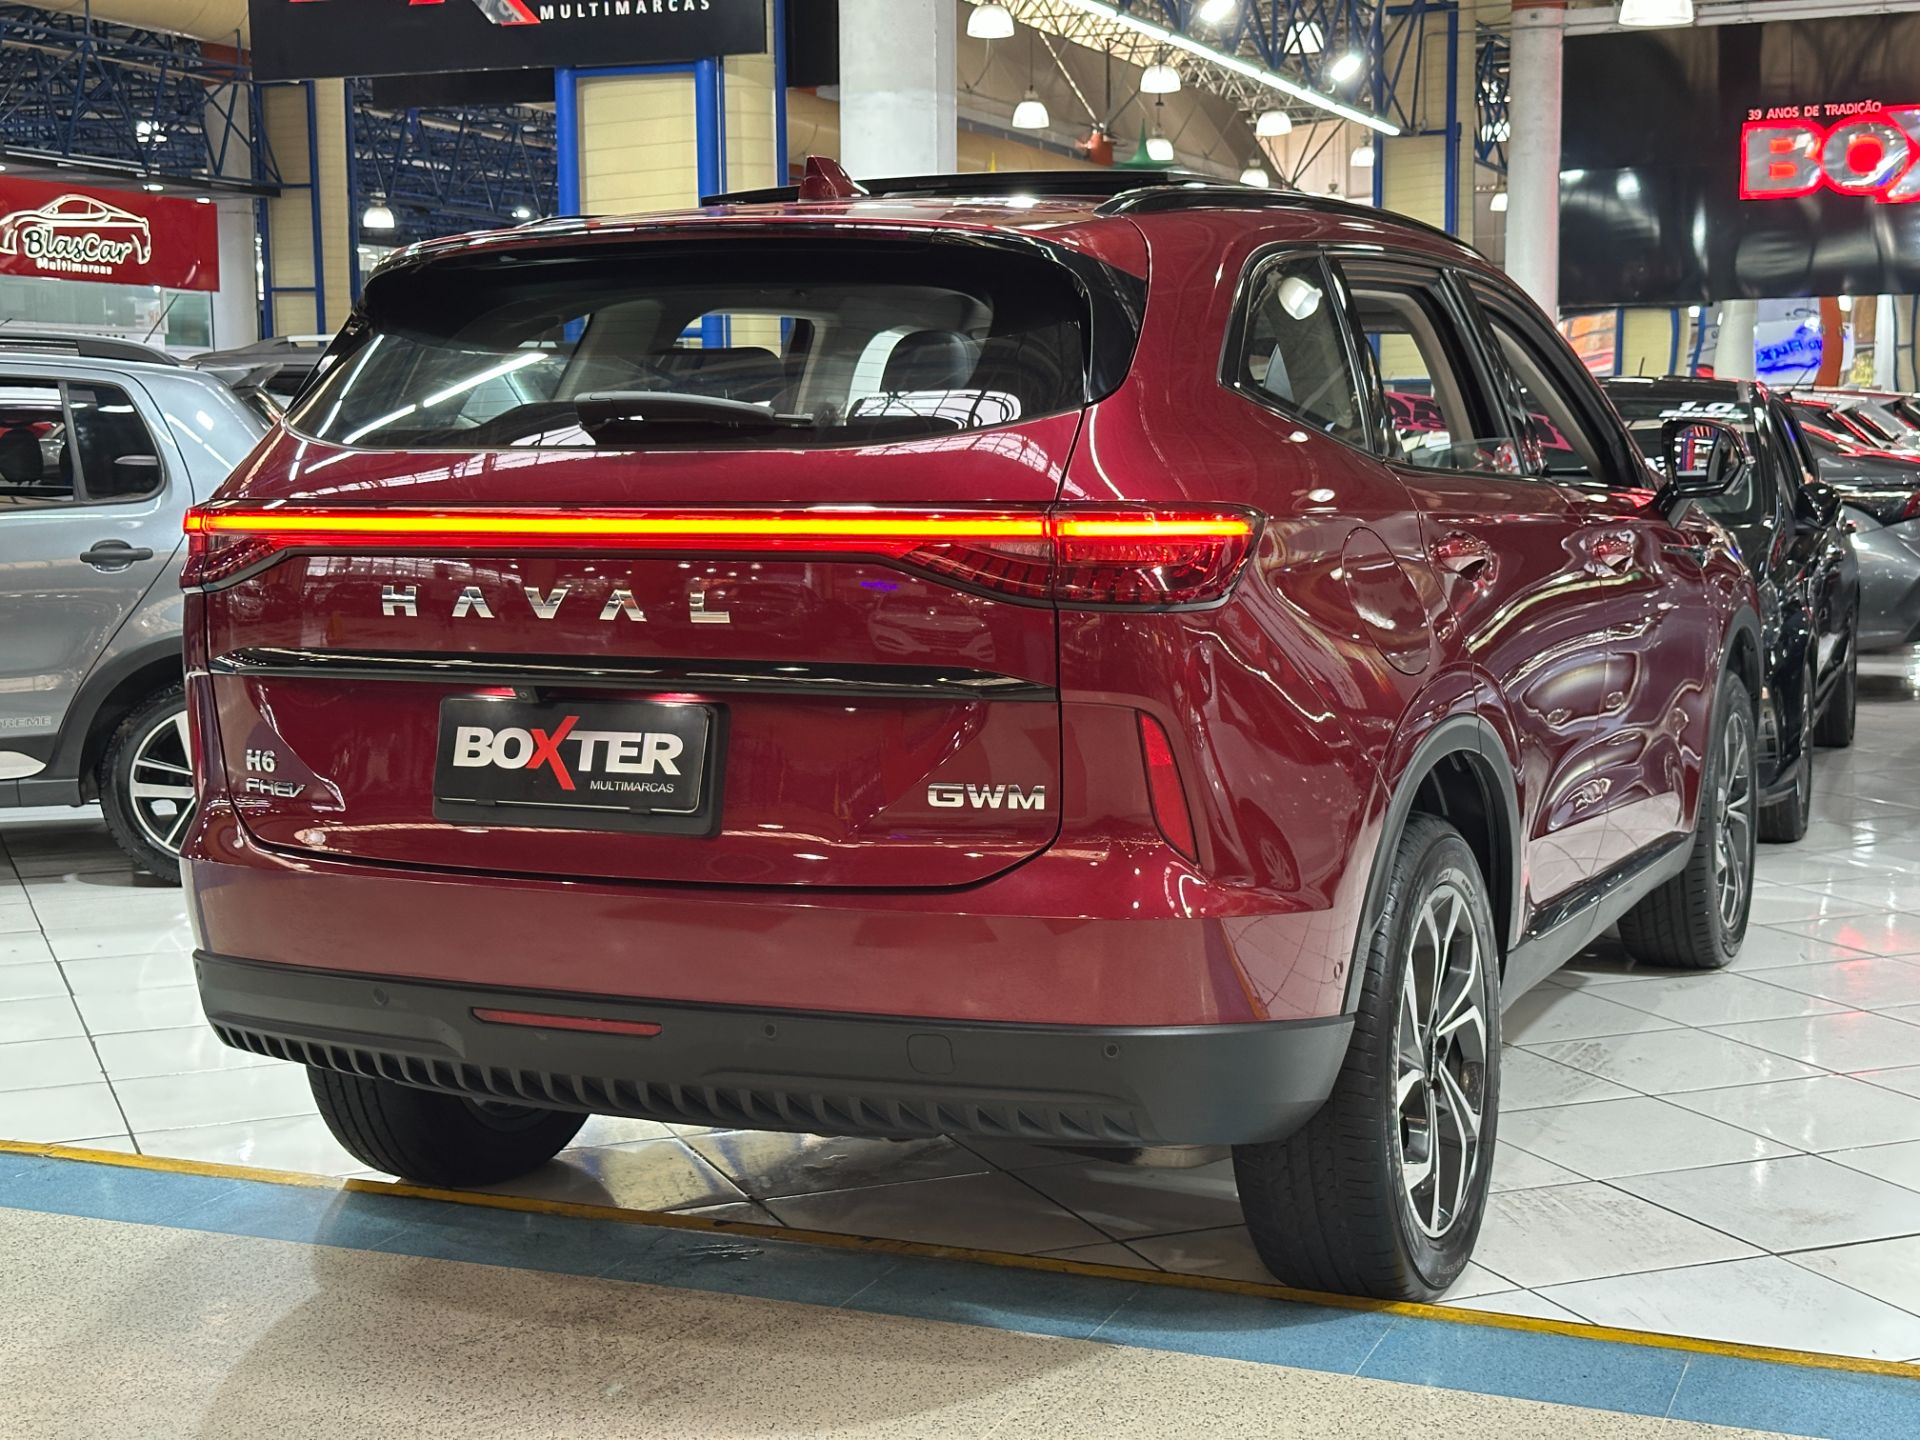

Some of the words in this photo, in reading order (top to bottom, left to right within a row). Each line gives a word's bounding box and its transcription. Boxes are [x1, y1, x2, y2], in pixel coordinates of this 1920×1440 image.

[540, 0, 710, 20] MULTIMARCAS
[1748, 109, 1763, 120] 39
[1766, 106, 1799, 119] ANOS
[1804, 105, 1819, 117] DE
[1824, 99, 1882, 117] TRADIÇÃO
[23, 226, 132, 264] BlasCar
[382, 585, 731, 624] HAVAL
[246, 749, 275, 772] H6
[453, 715, 684, 791] BOXTER
[590, 780, 674, 793] MULTIMARCAS
[927, 783, 1045, 810] GWM
